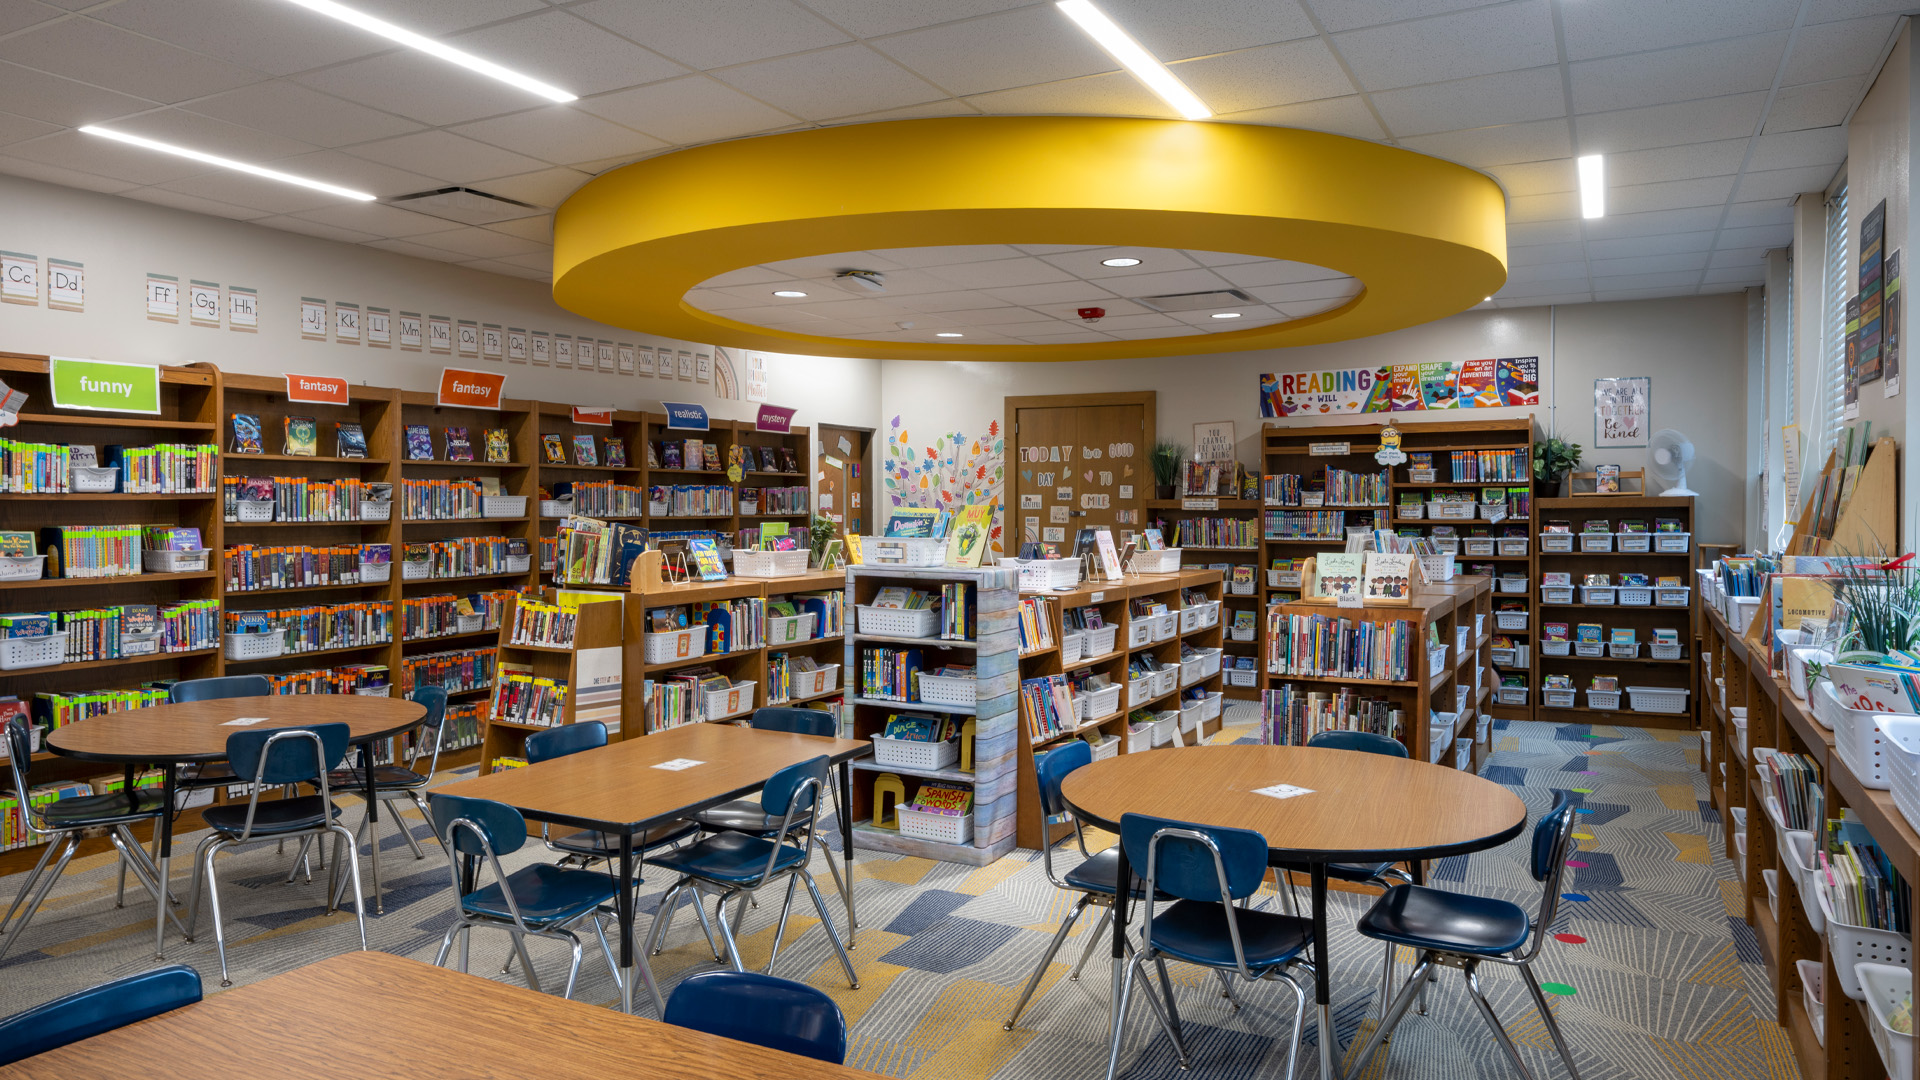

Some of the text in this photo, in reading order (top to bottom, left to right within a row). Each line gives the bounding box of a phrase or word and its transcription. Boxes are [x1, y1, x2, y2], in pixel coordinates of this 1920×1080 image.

[8, 266, 31, 284] Cc
[56, 272, 78, 291] Dd
[155, 286, 171, 302] Ff
[195, 293, 216, 316] Gg
[234, 298, 252, 315] Hh
[308, 309, 320, 330] Jj
[341, 314, 355, 328] Kk
[373, 318, 384, 332] Ll
[402, 322, 420, 337] Mm
[433, 326, 447, 339] Nn
[461, 330, 474, 343] Oo
[487, 333, 498, 351] Pp
[511, 337, 524, 355] Qq
[536, 340, 546, 352] Rr
[560, 343, 568, 355] Ss
[582, 345, 590, 358] Tt
[601, 348, 611, 360] Uu
[662, 356, 670, 367] Xx
[682, 358, 689, 374] Yy
[700, 361, 707, 373] Zz
[1420, 363, 1443, 371] SHAPE
[1393, 364, 1418, 372] EXPAND
[1393, 371, 1408, 379] your
[1523, 373, 1536, 382] BIG
[79, 375, 133, 398] funny
[300, 379, 339, 394] fantasy
[1282, 369, 1371, 395] READING
[452, 380, 492, 397] fantasy
[1615, 387, 1628, 396] ARE
[1317, 394, 1338, 403] WILL
[1621, 396, 1635, 404] THIS
[674, 409, 703, 420] realistic
[1601, 405, 1645, 416] TOGETHER
[761, 413, 787, 425] mystery
[1604, 418, 1622, 430] Be
[1604, 427, 1640, 439] Kind
[1202, 436, 1226, 445] CHANGE
[1020, 446, 1073, 463] TODAY
[1109, 443, 1134, 459] GOOD
[1212, 443, 1232, 451] WORLD
[69, 452, 96, 460] KITTY
[1211, 451, 1230, 459] BEING
[1038, 471, 1113, 487] DAY TO
[1081, 494, 1109, 508] SMILE
[967, 509, 986, 518] MUY
[1116, 510, 1138, 524] LEARN
[1048, 533, 1060, 541] BIG
[1787, 608, 1826, 616] LOCOMOTIVE
[240, 615, 266, 627] SEEKERS
[15, 629, 35, 637] Wimpy
[1839, 683, 1858, 696] The
[893, 721, 916, 734] DULCE
[906, 731, 926, 740] truco
[925, 787, 965, 802] SPANISH
[925, 799, 957, 810] WORDS
